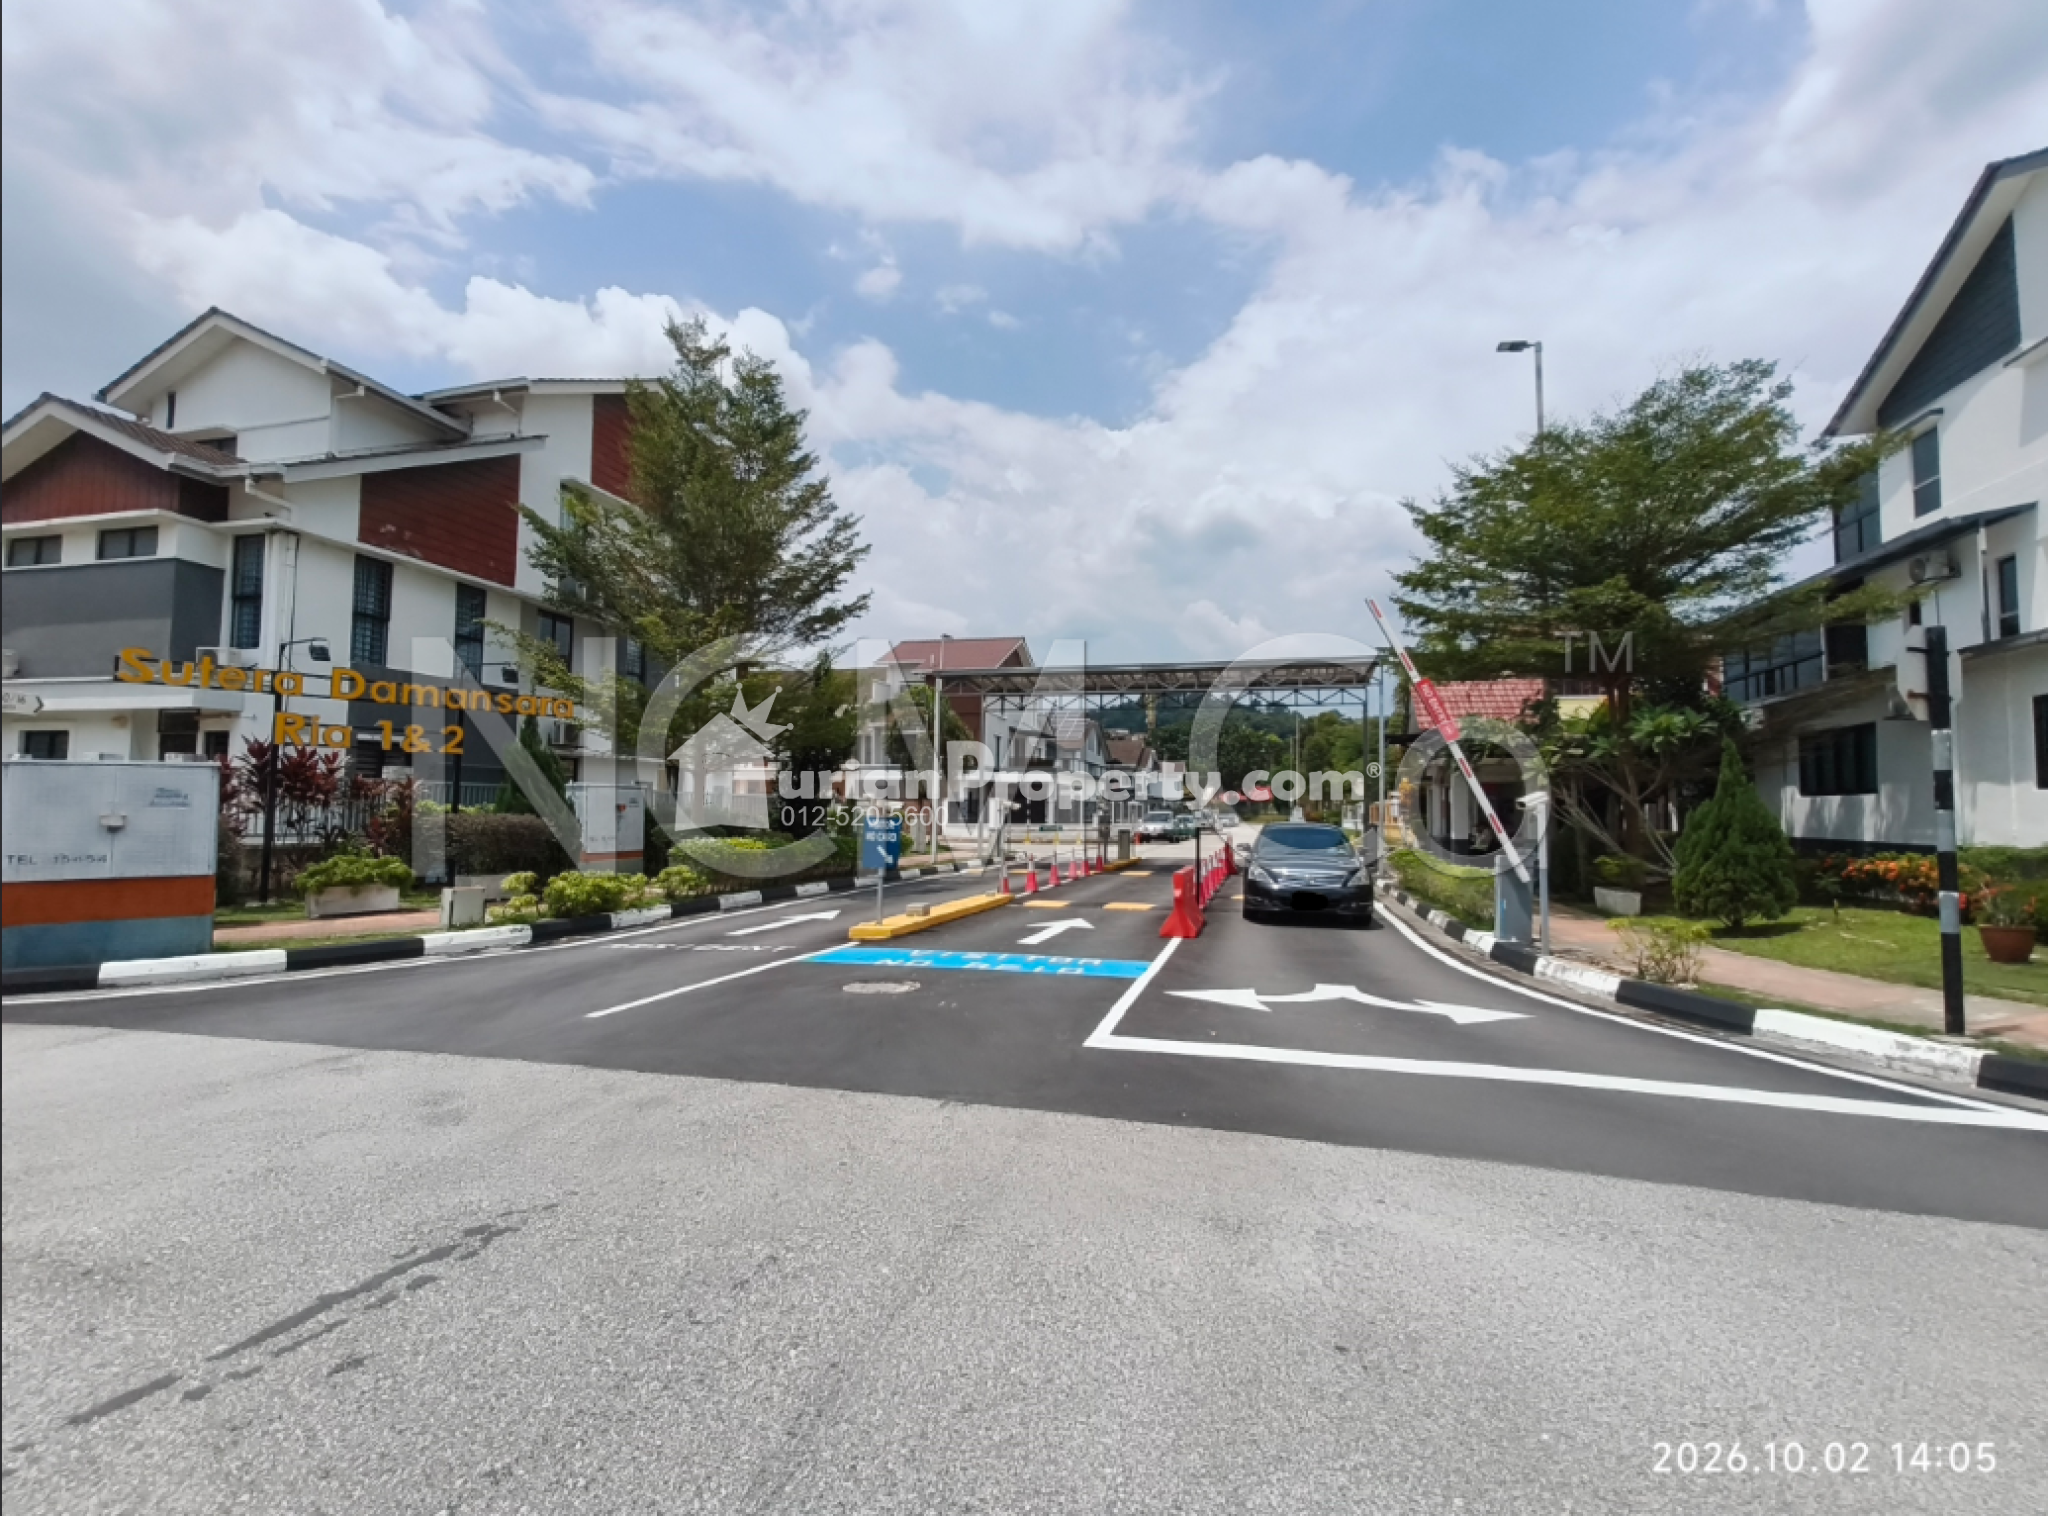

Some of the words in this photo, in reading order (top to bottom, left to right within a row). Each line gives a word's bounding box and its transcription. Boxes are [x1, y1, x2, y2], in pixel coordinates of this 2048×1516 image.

[119, 647, 303, 697] Sutera
[330, 667, 575, 719] Damansara
[274, 712, 352, 749] Ria
[6, 854, 38, 866] TEL
